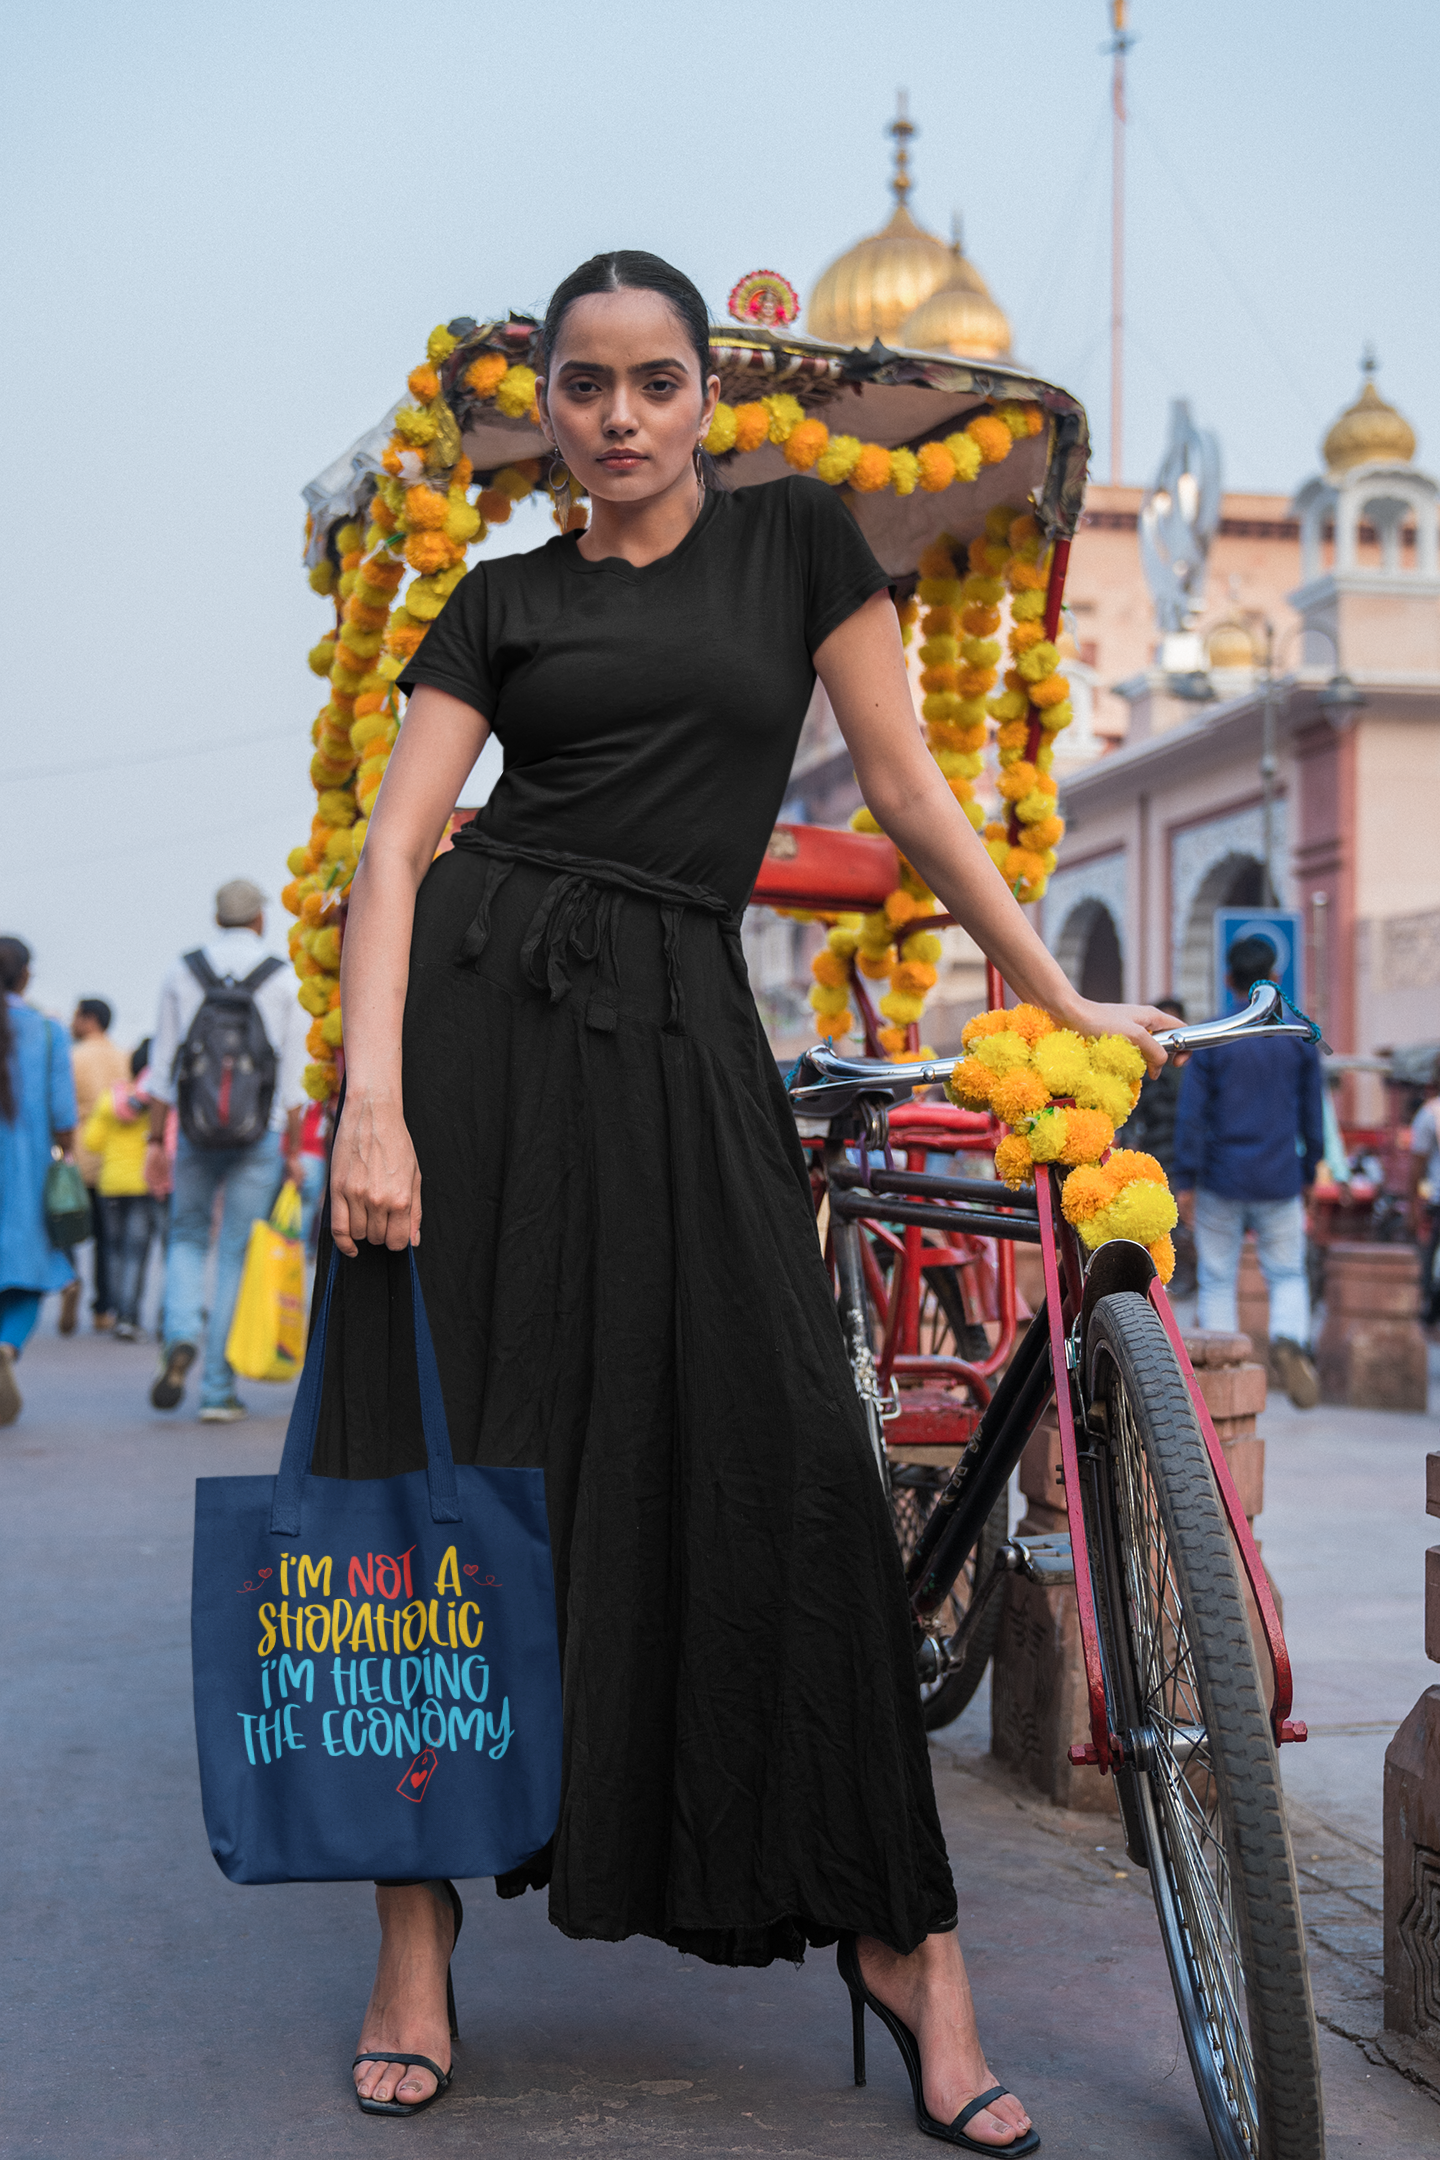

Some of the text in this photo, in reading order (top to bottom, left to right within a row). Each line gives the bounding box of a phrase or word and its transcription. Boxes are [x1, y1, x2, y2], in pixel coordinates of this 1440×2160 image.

[348, 1544, 416, 1600] NOT
[434, 1545, 462, 1597] A
[237, 1697, 515, 1765] THE ECONOMY
